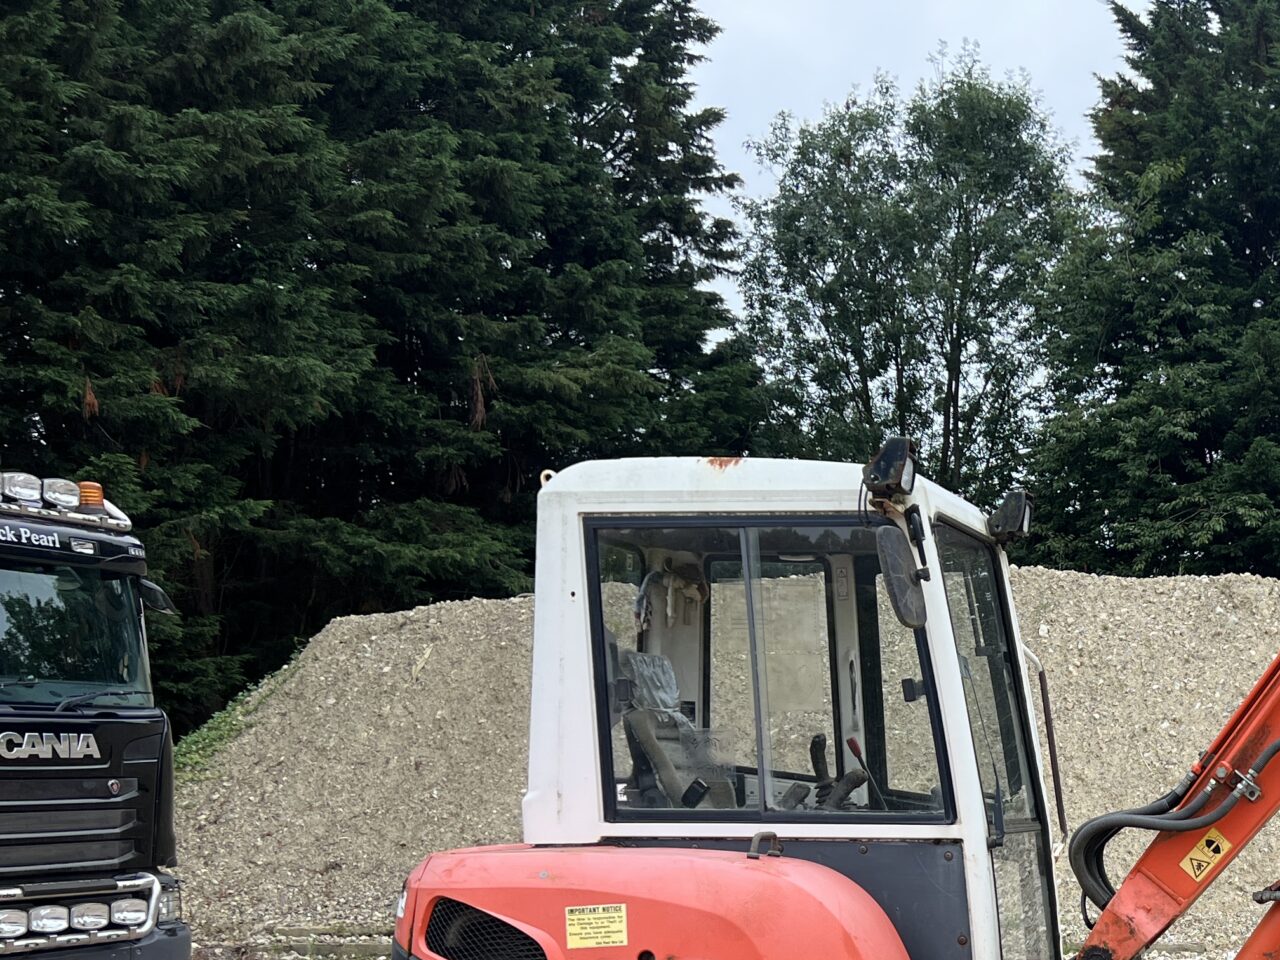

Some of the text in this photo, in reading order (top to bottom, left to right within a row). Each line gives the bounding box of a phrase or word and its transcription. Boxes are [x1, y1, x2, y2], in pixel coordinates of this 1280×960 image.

[19, 527, 61, 548] Pearl
[567, 905, 622, 915] IMPORTANT NOTICE
